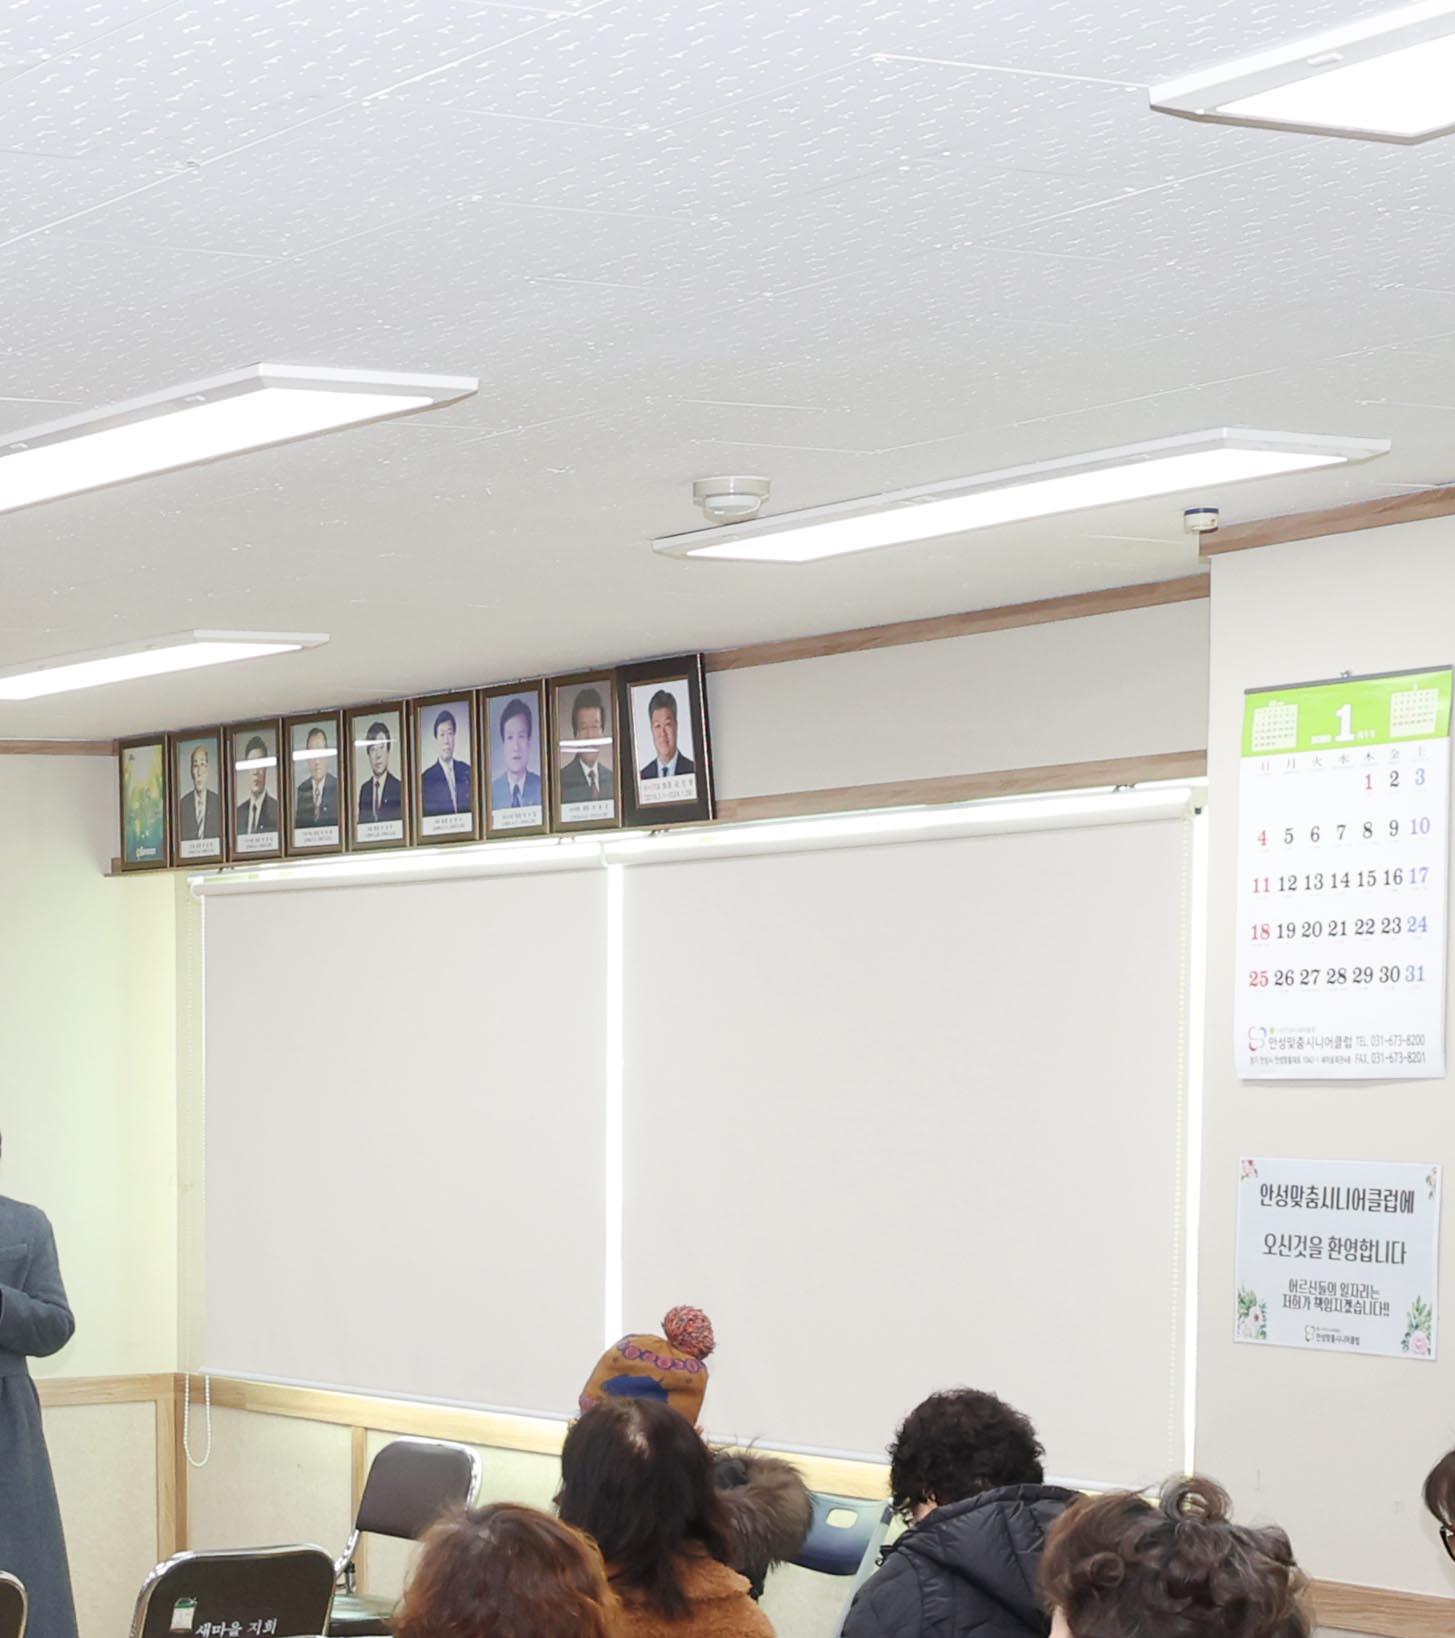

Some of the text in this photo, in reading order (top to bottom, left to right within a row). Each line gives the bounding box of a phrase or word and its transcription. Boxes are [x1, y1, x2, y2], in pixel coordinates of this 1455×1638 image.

[1336, 704, 1355, 742] 1
[1365, 767, 1426, 791] 1 2 3
[1256, 816, 1431, 847] 4 5 6 7 8 9 10
[1253, 866, 1429, 894] 11 12 13 14 15 16 17
[1251, 915, 1428, 941] 18 19 20 21 22 23 24
[1248, 964, 1425, 988] 25 26 27 28 29 30 31
[1259, 1183, 1416, 1215] 안성맞춤시니어클럽에
[1262, 1233, 1408, 1265] 오신것을 환영합니다
[1281, 1293, 1312, 1311] 저희가
[1288, 1278, 1381, 1301] 어르신들의 일자리는
[195, 1618, 278, 1638] 새마을 지회
